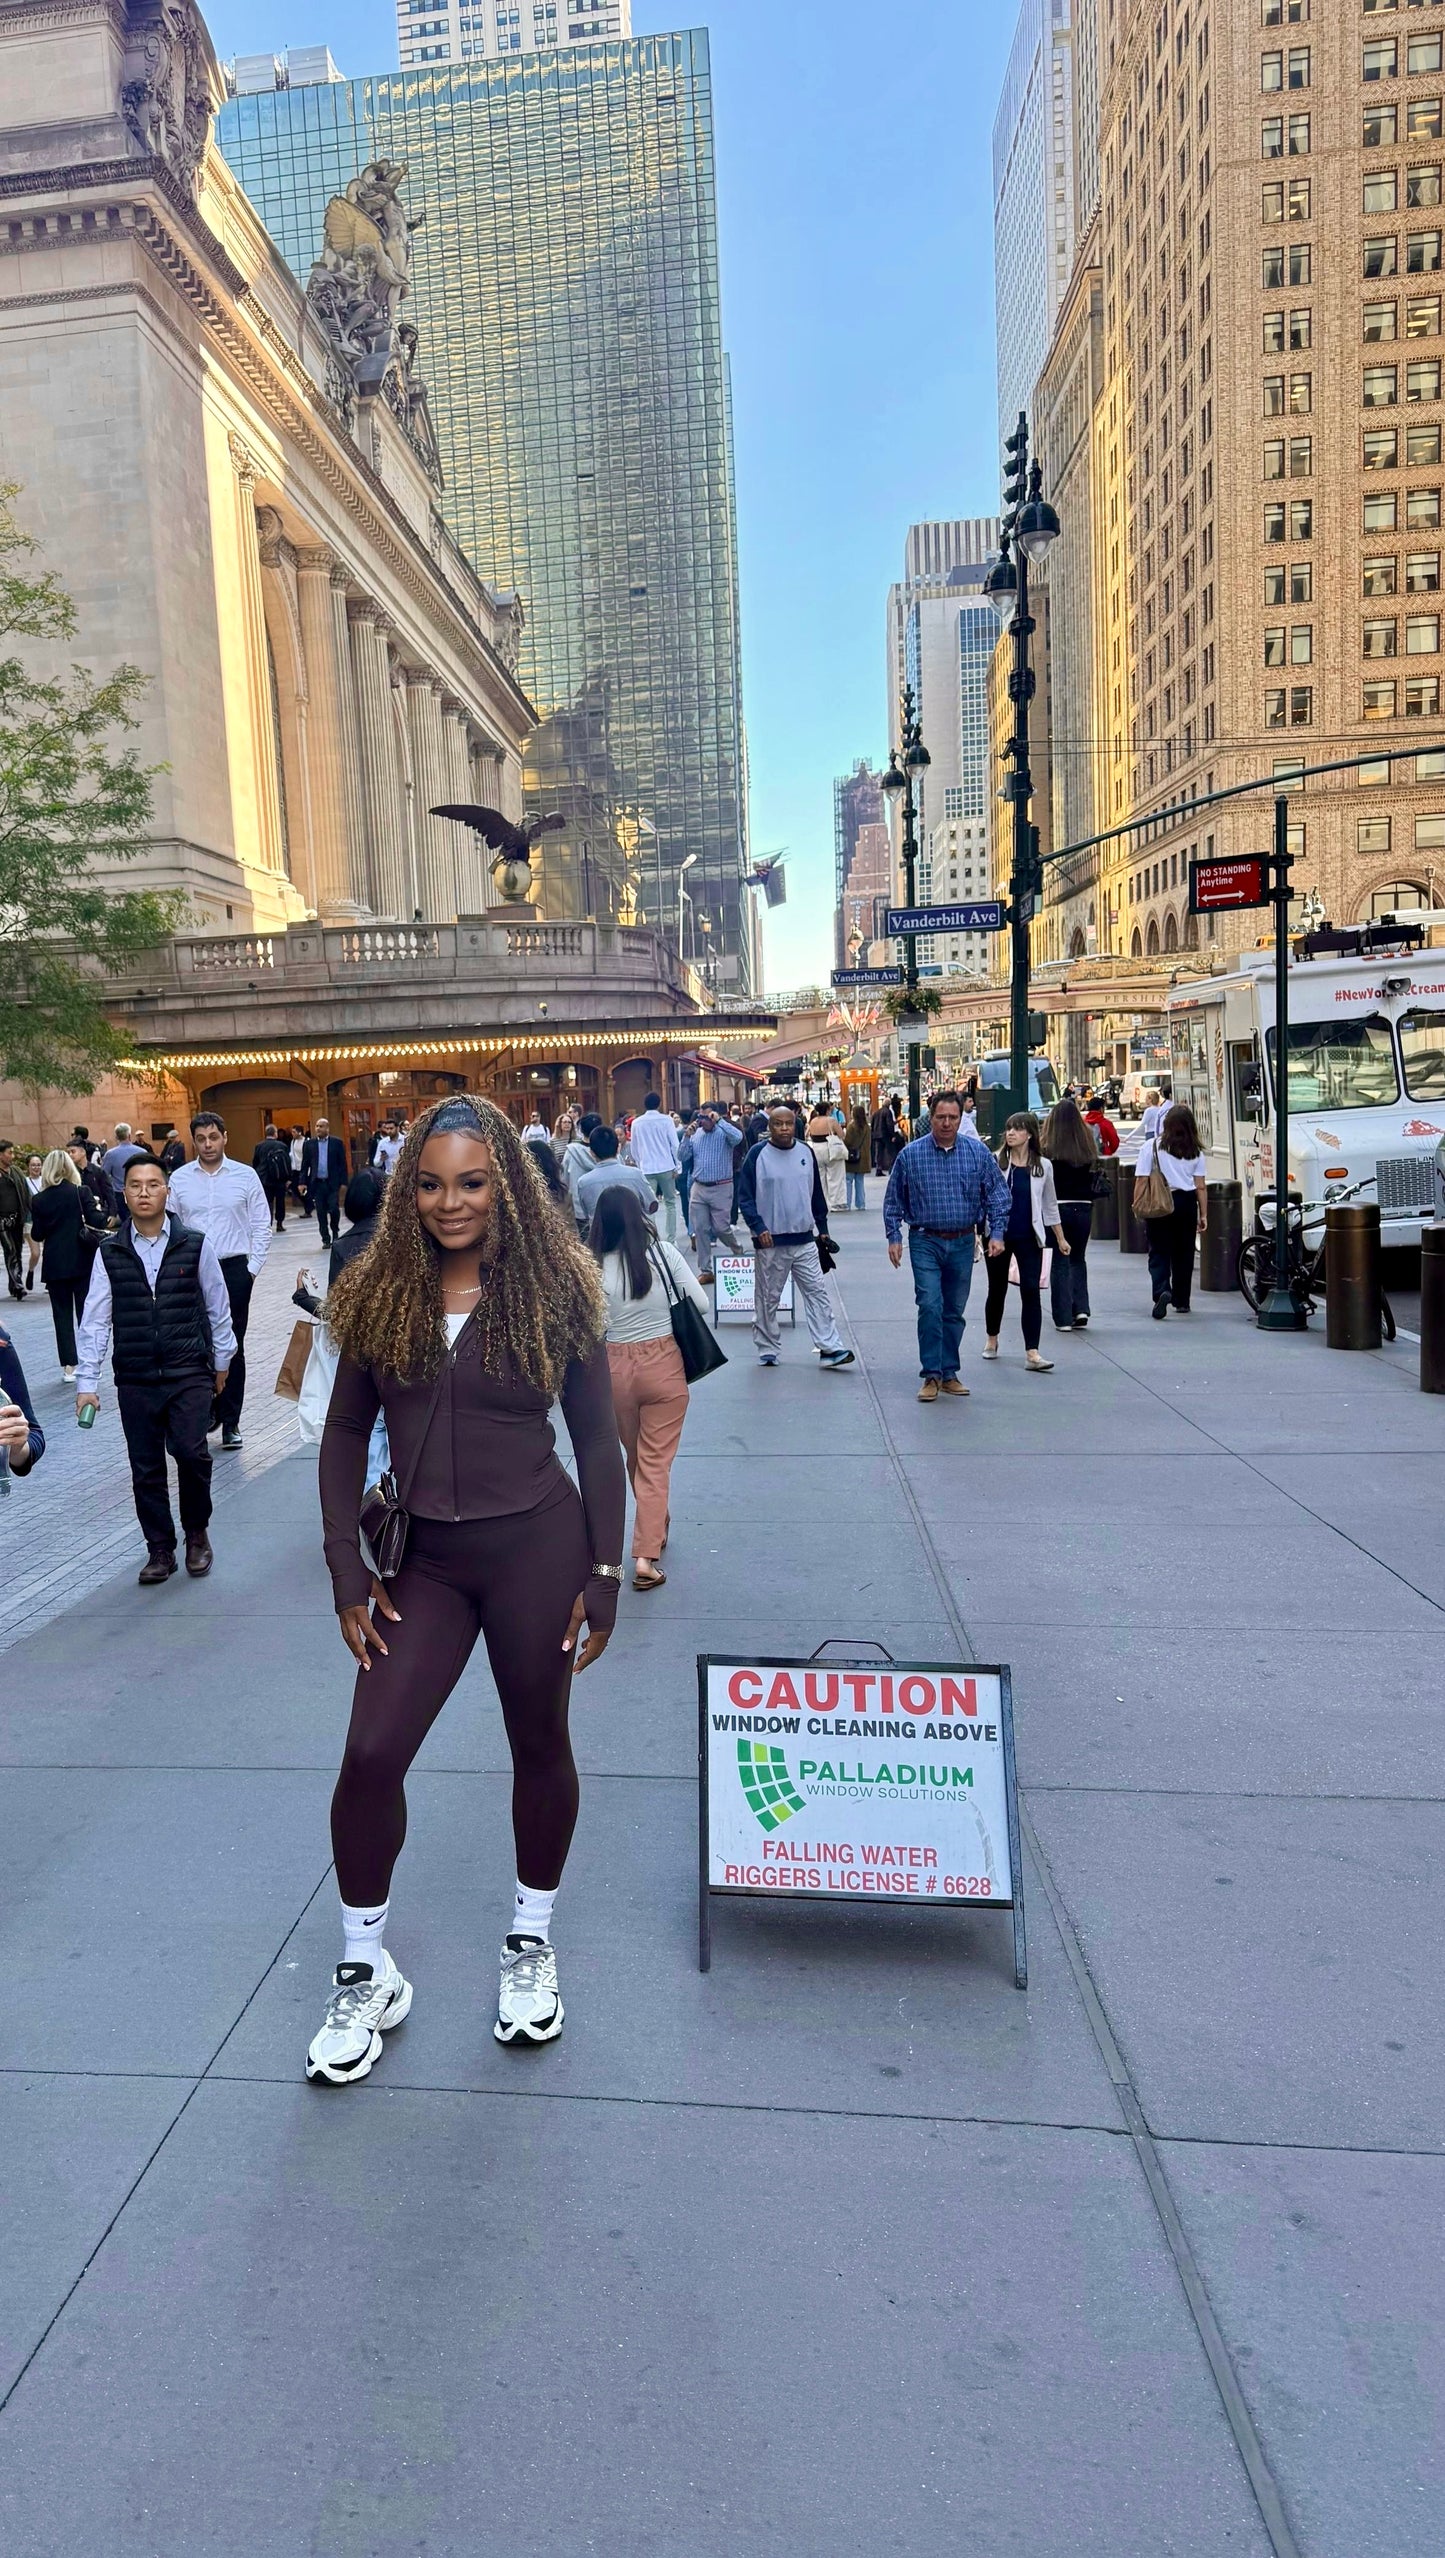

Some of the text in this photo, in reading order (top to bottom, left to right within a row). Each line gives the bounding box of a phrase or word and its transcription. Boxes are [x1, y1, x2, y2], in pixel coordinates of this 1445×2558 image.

[1200, 864, 1252, 877] NO STANDING
[1200, 877, 1233, 888] Anytime
[891, 910, 997, 929] Vanderbilt Ave
[834, 972, 898, 983] Vanderbilt Ave
[727, 1669, 978, 1717] CAUTION
[712, 1714, 998, 1742] WINDOW CLEANING ABOVE
[799, 1760, 974, 1787] PALLADIUM
[806, 1784, 967, 1802] WINDOW SOLUTIONS
[762, 1840, 938, 1867] FALLING WATER
[725, 1864, 992, 1896] RIGGERS LICENSE # 6628
